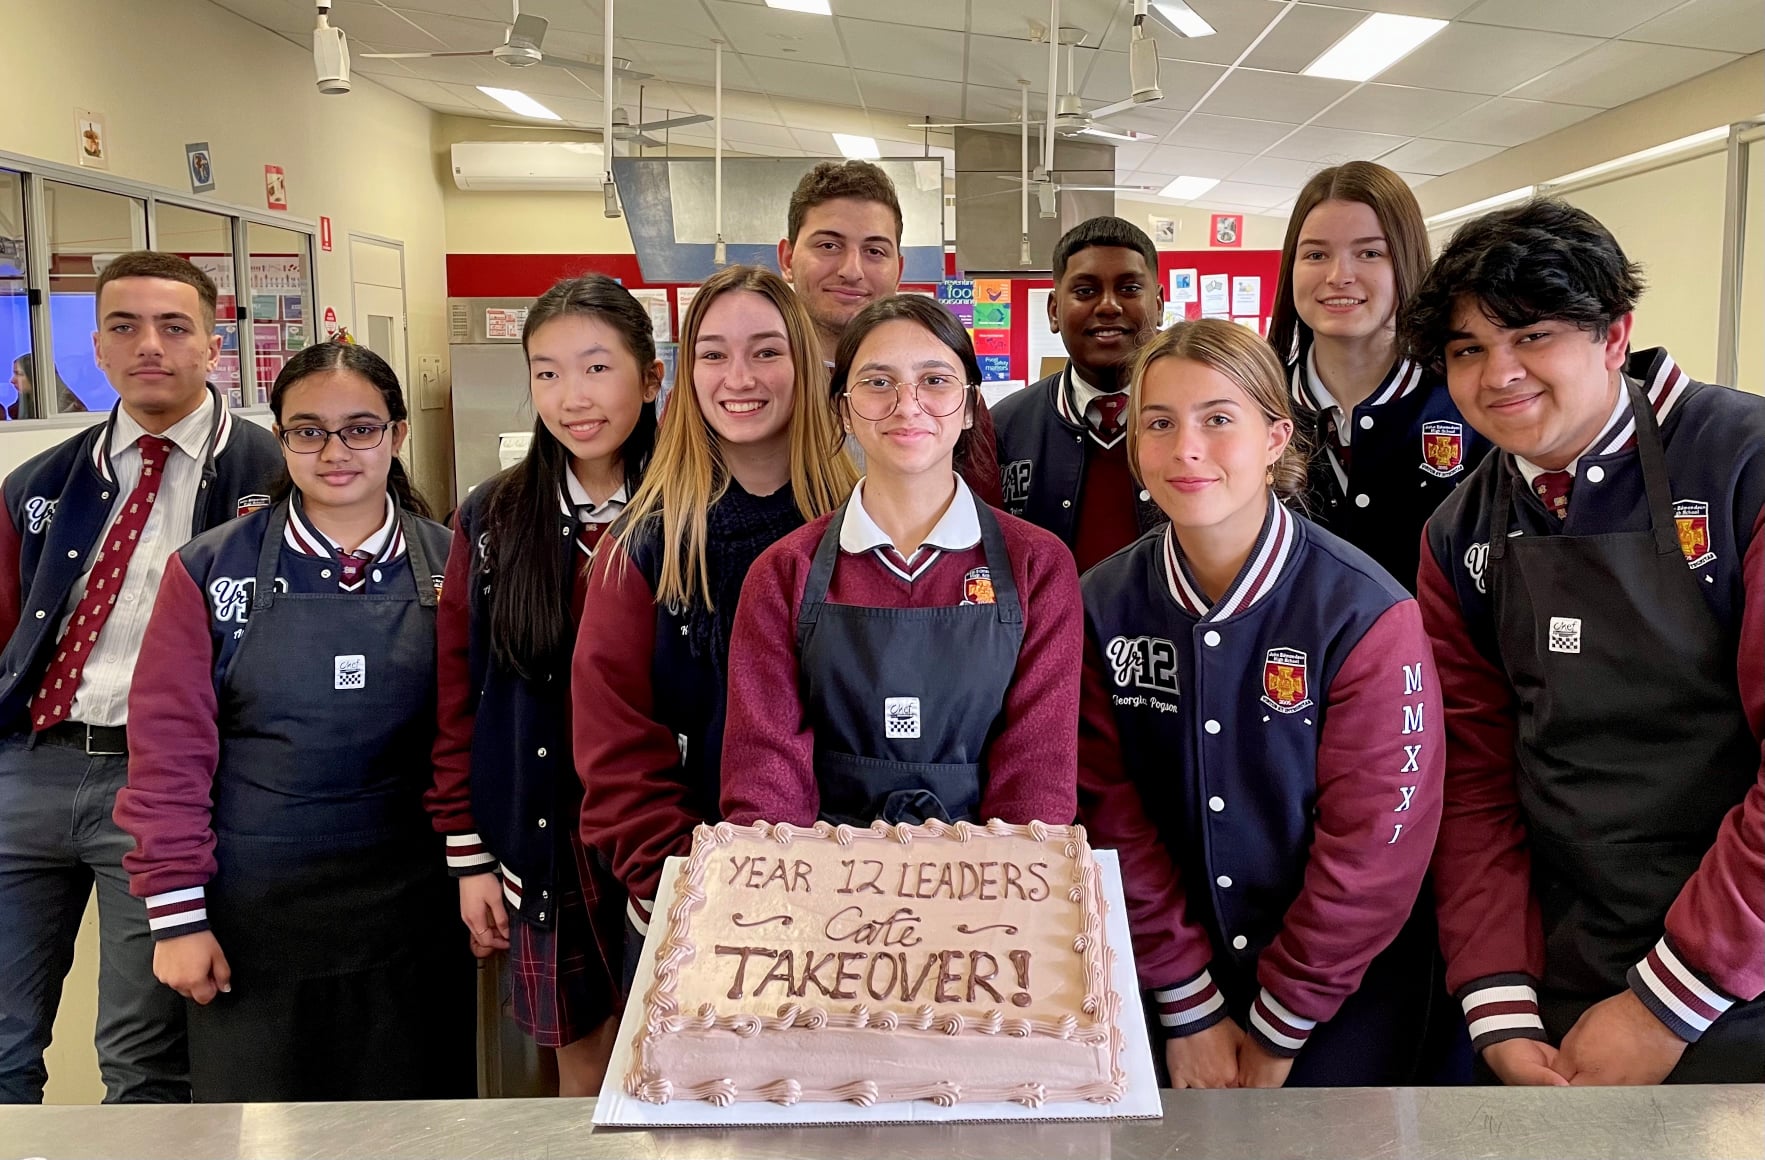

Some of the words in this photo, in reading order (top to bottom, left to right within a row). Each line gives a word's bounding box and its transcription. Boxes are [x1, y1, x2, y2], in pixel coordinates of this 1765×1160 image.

[1553, 621, 1576, 632] Chef
[339, 659, 360, 670] Chef
[889, 702, 913, 715] Chef
[728, 856, 813, 893] YEAR
[837, 859, 886, 895] 12
[898, 861, 1051, 902] LEADERS
[714, 945, 1033, 1008] TAKEOVER!
